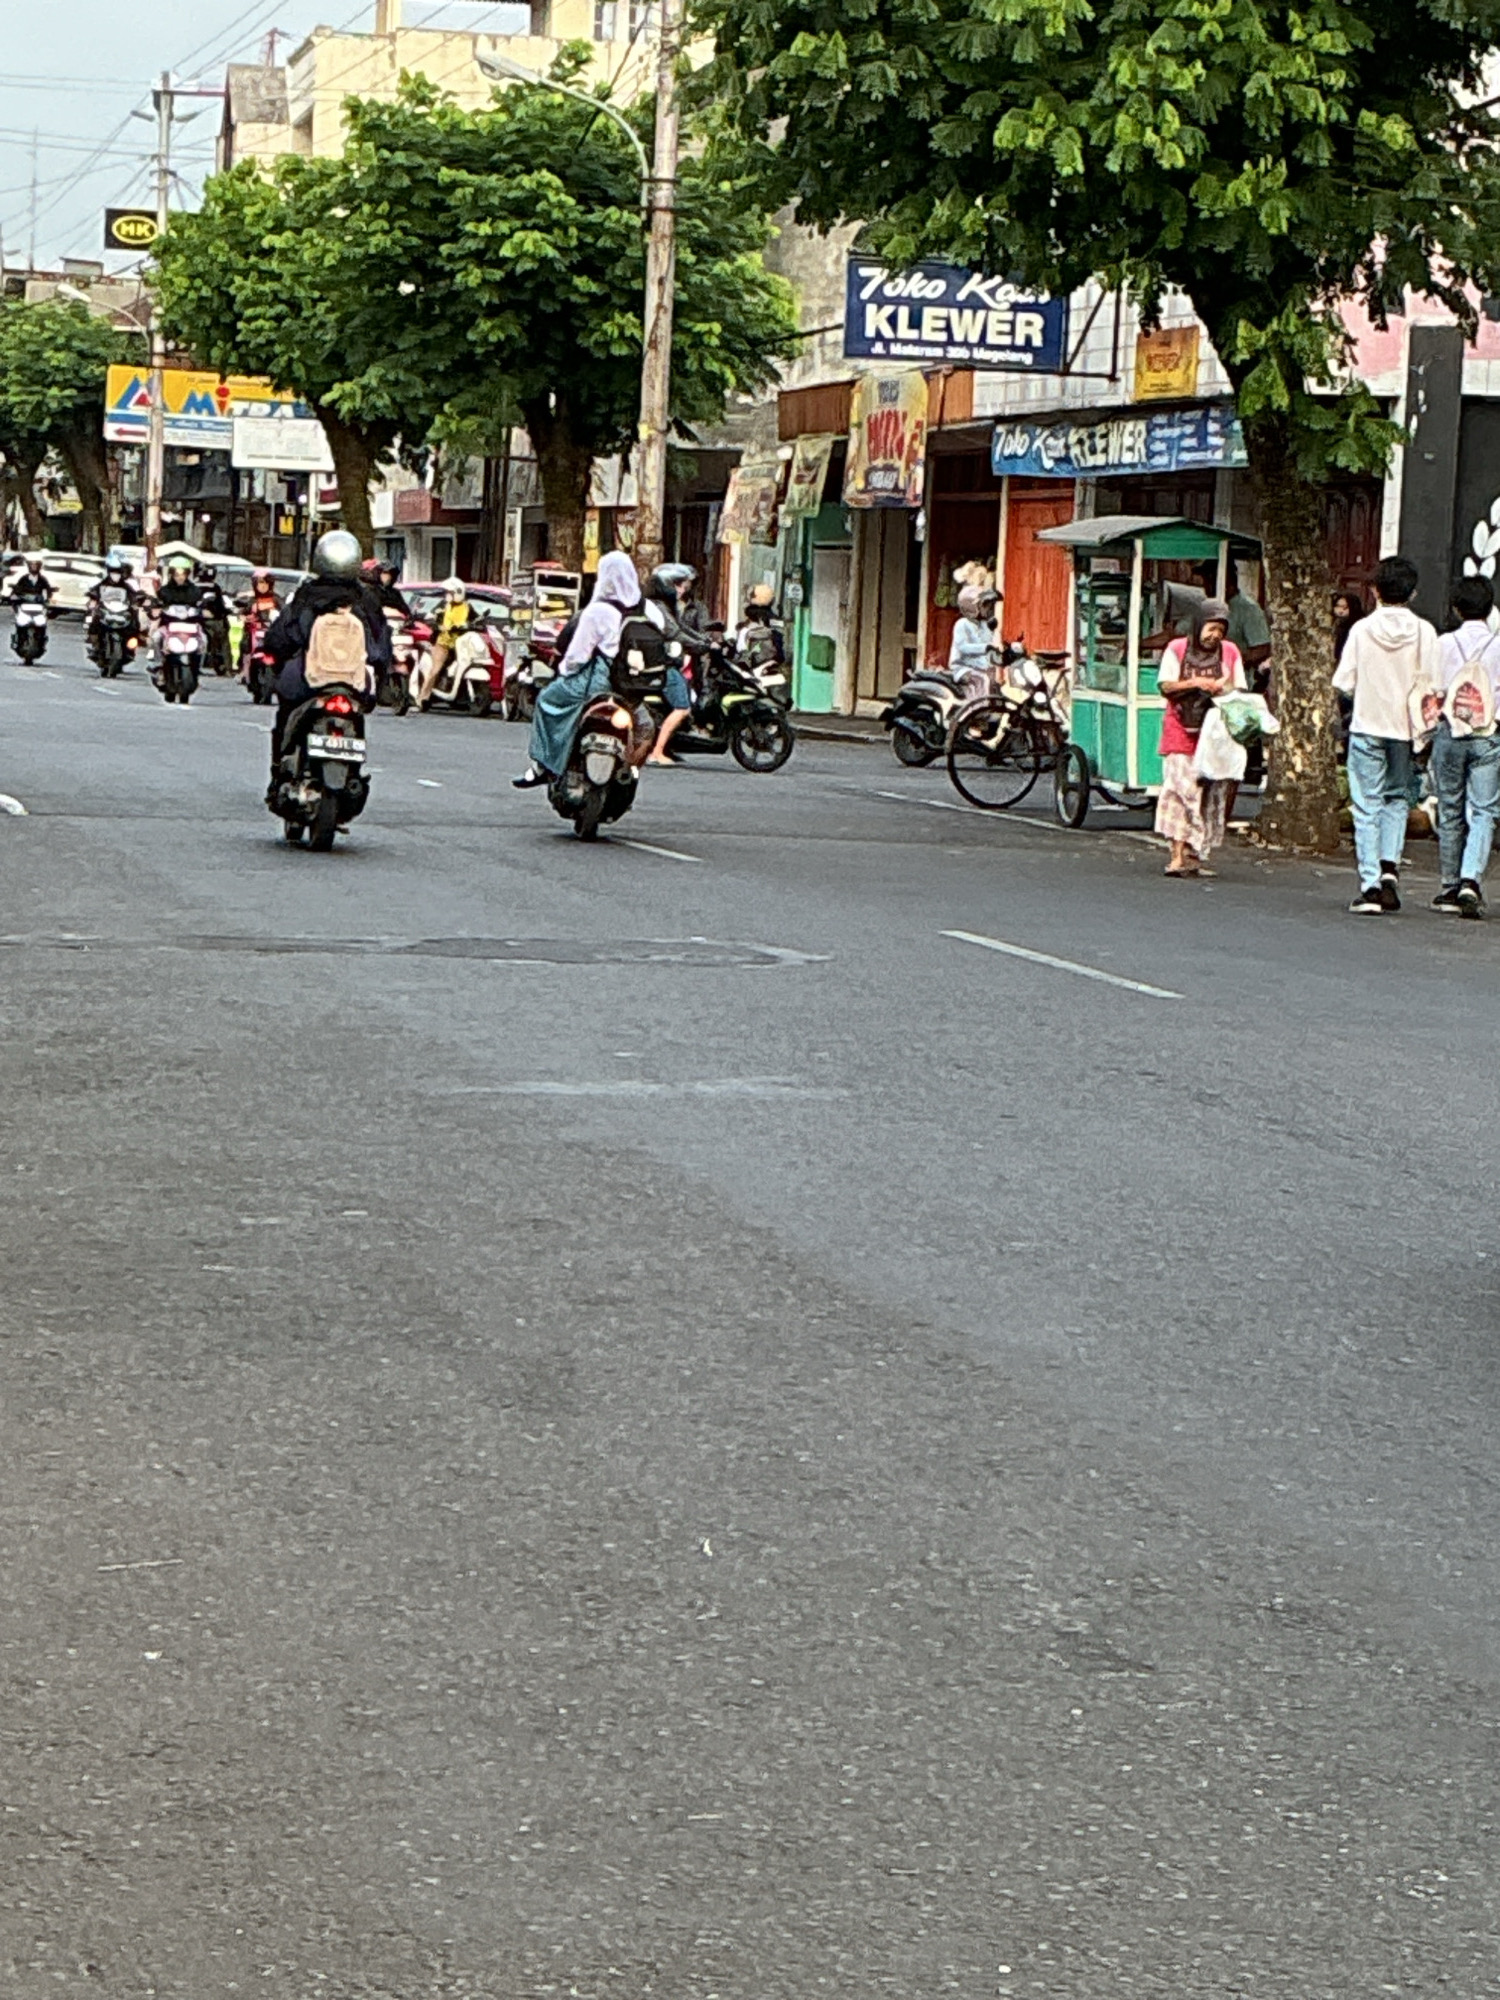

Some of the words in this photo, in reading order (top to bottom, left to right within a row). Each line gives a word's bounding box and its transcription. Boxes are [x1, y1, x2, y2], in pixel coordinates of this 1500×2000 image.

[858, 267, 947, 300] Toko
[865, 303, 1045, 348] KLEWER
[1068, 419, 1147, 468] KLEWER
